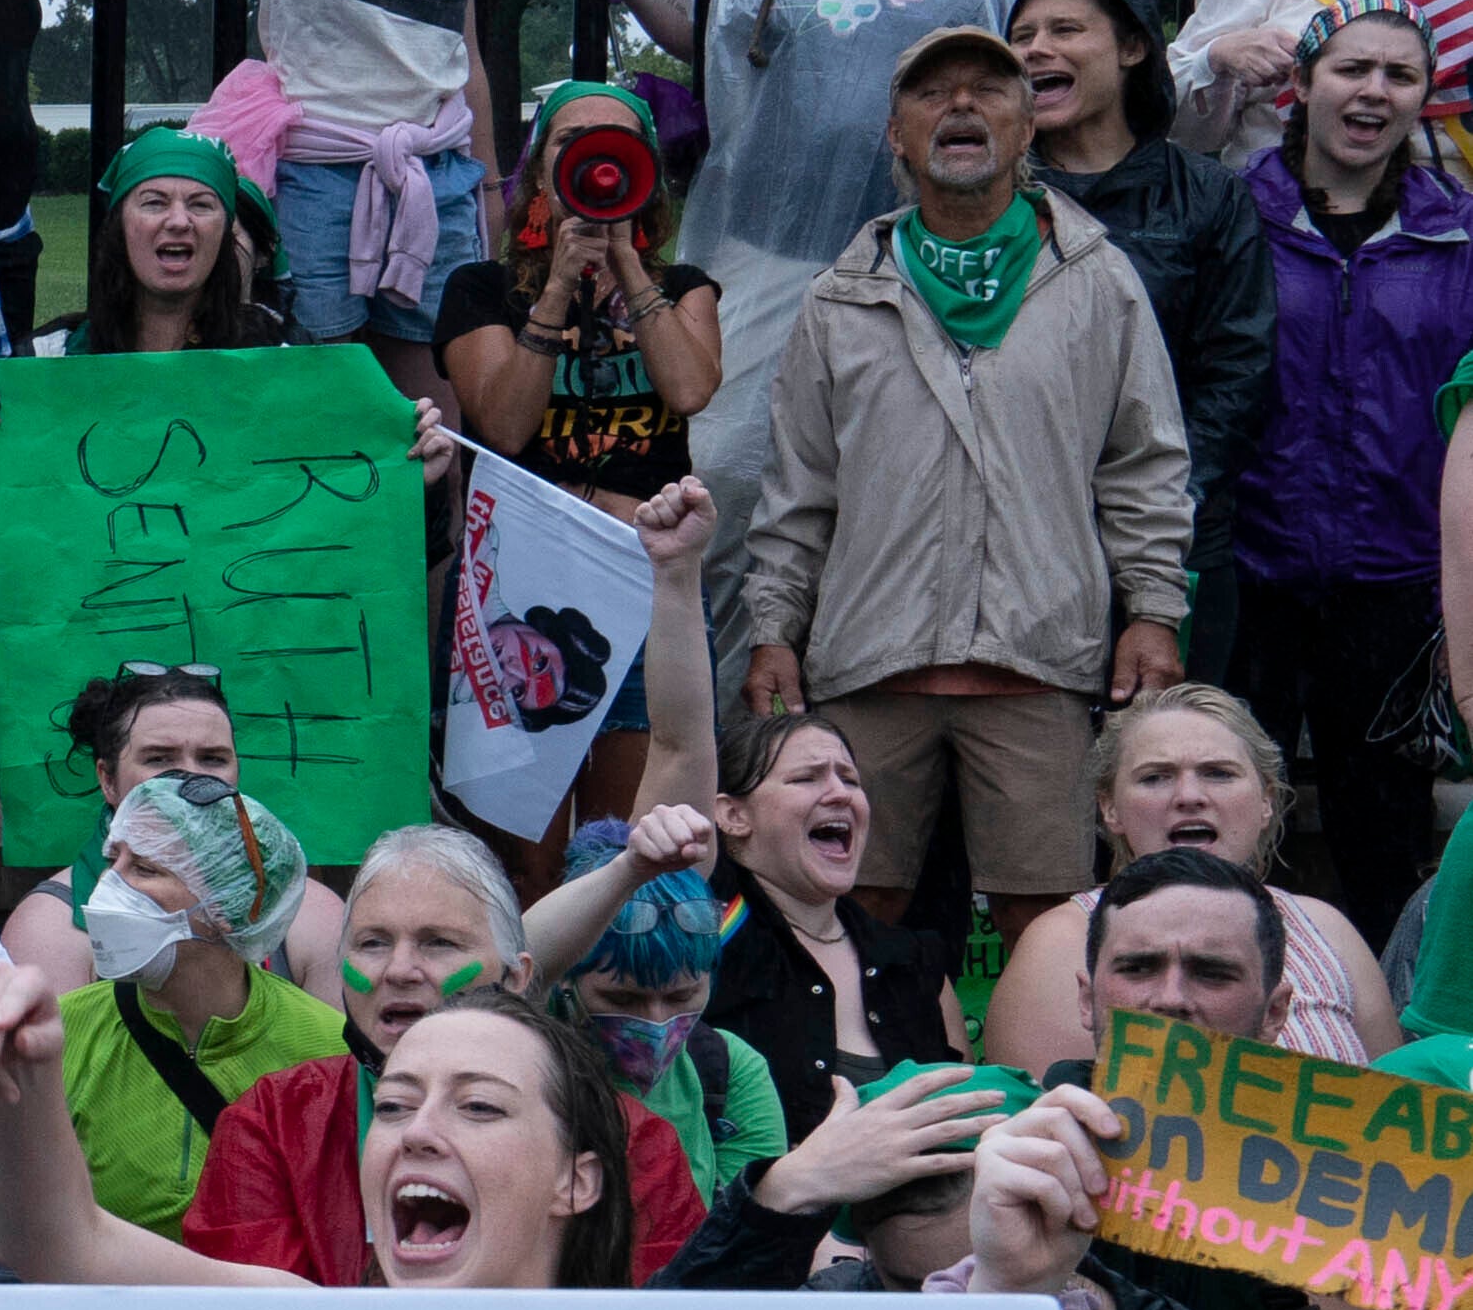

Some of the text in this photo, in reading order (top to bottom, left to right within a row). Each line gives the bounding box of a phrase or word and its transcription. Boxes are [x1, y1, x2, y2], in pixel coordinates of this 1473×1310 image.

[920, 239, 979, 276] OFF
[222, 451, 379, 779] RUTH
[1104, 1008, 1361, 1152] FREE
[1098, 1167, 1326, 1264] ithout
